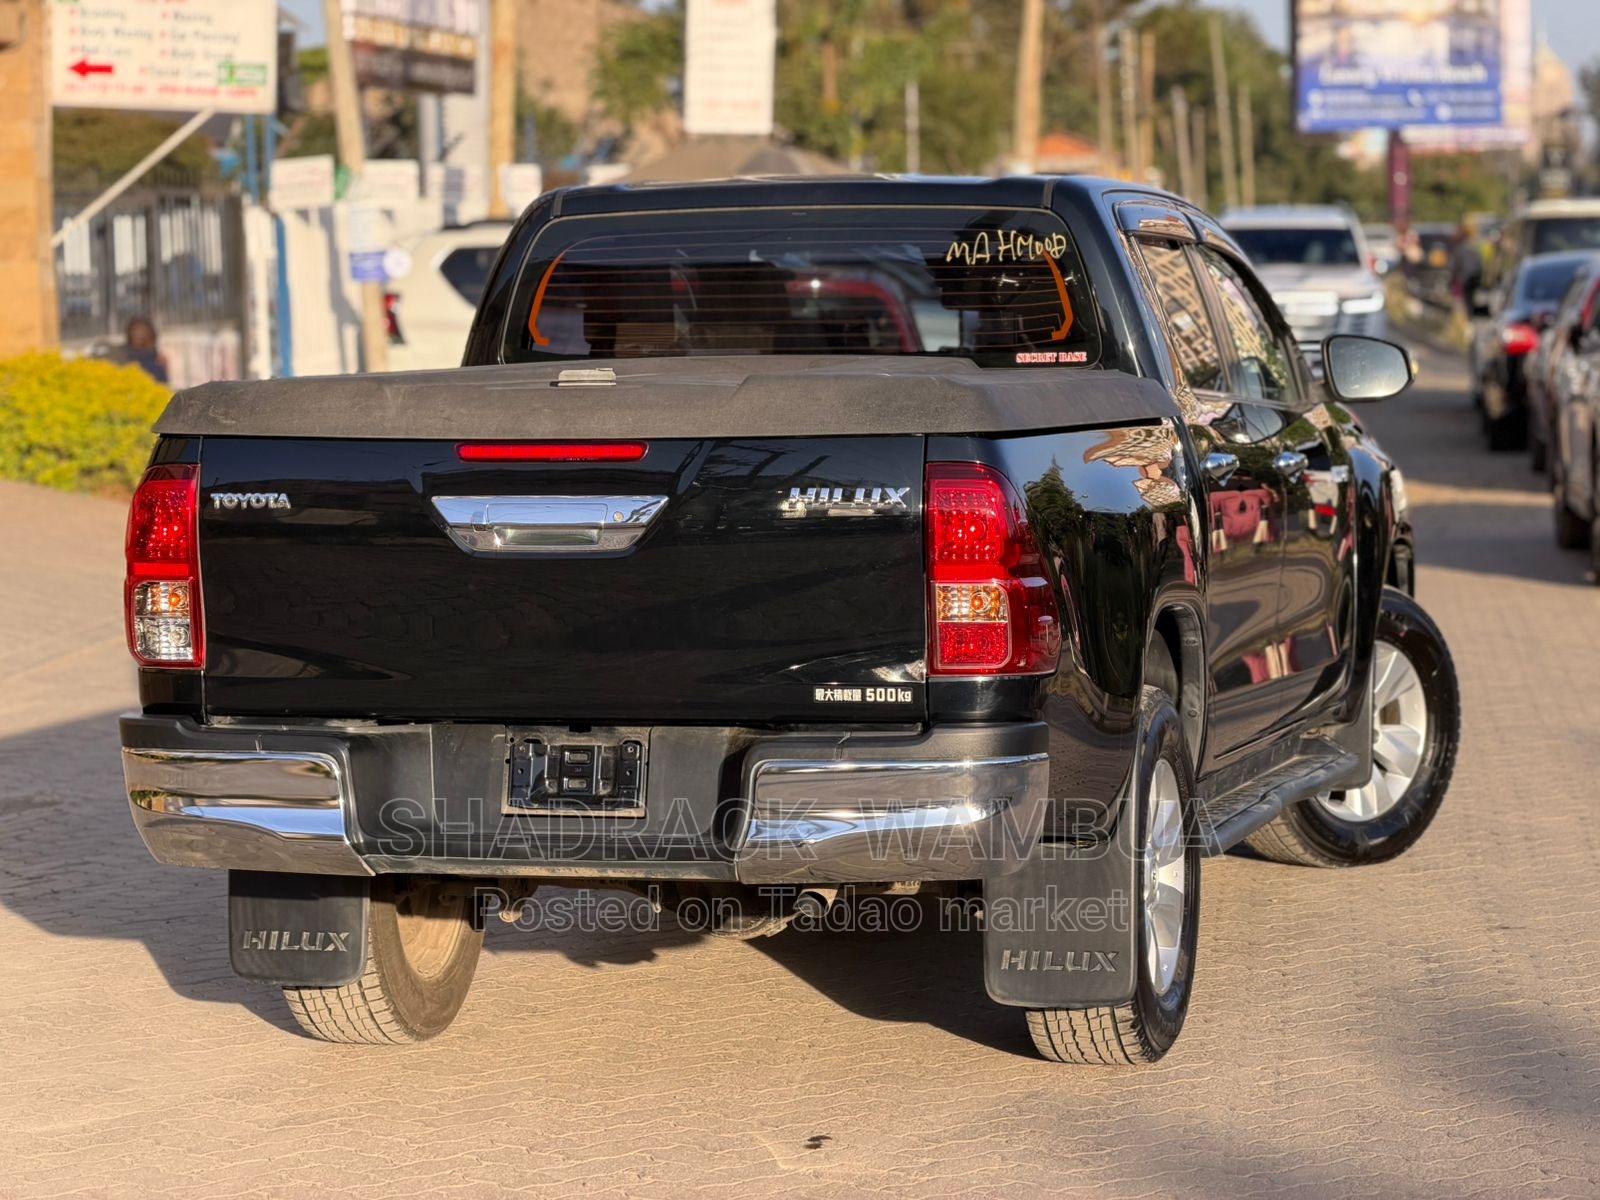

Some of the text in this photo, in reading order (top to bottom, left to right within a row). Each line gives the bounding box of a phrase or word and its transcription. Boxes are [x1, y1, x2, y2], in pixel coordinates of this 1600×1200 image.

[1016, 351, 1088, 364] SECRET BASE
[210, 492, 292, 510] TOYOTA
[783, 487, 911, 509] HILUX
[866, 688, 912, 702] 500kg
[243, 930, 350, 952] HILUX
[1000, 949, 1119, 972] HILUX
